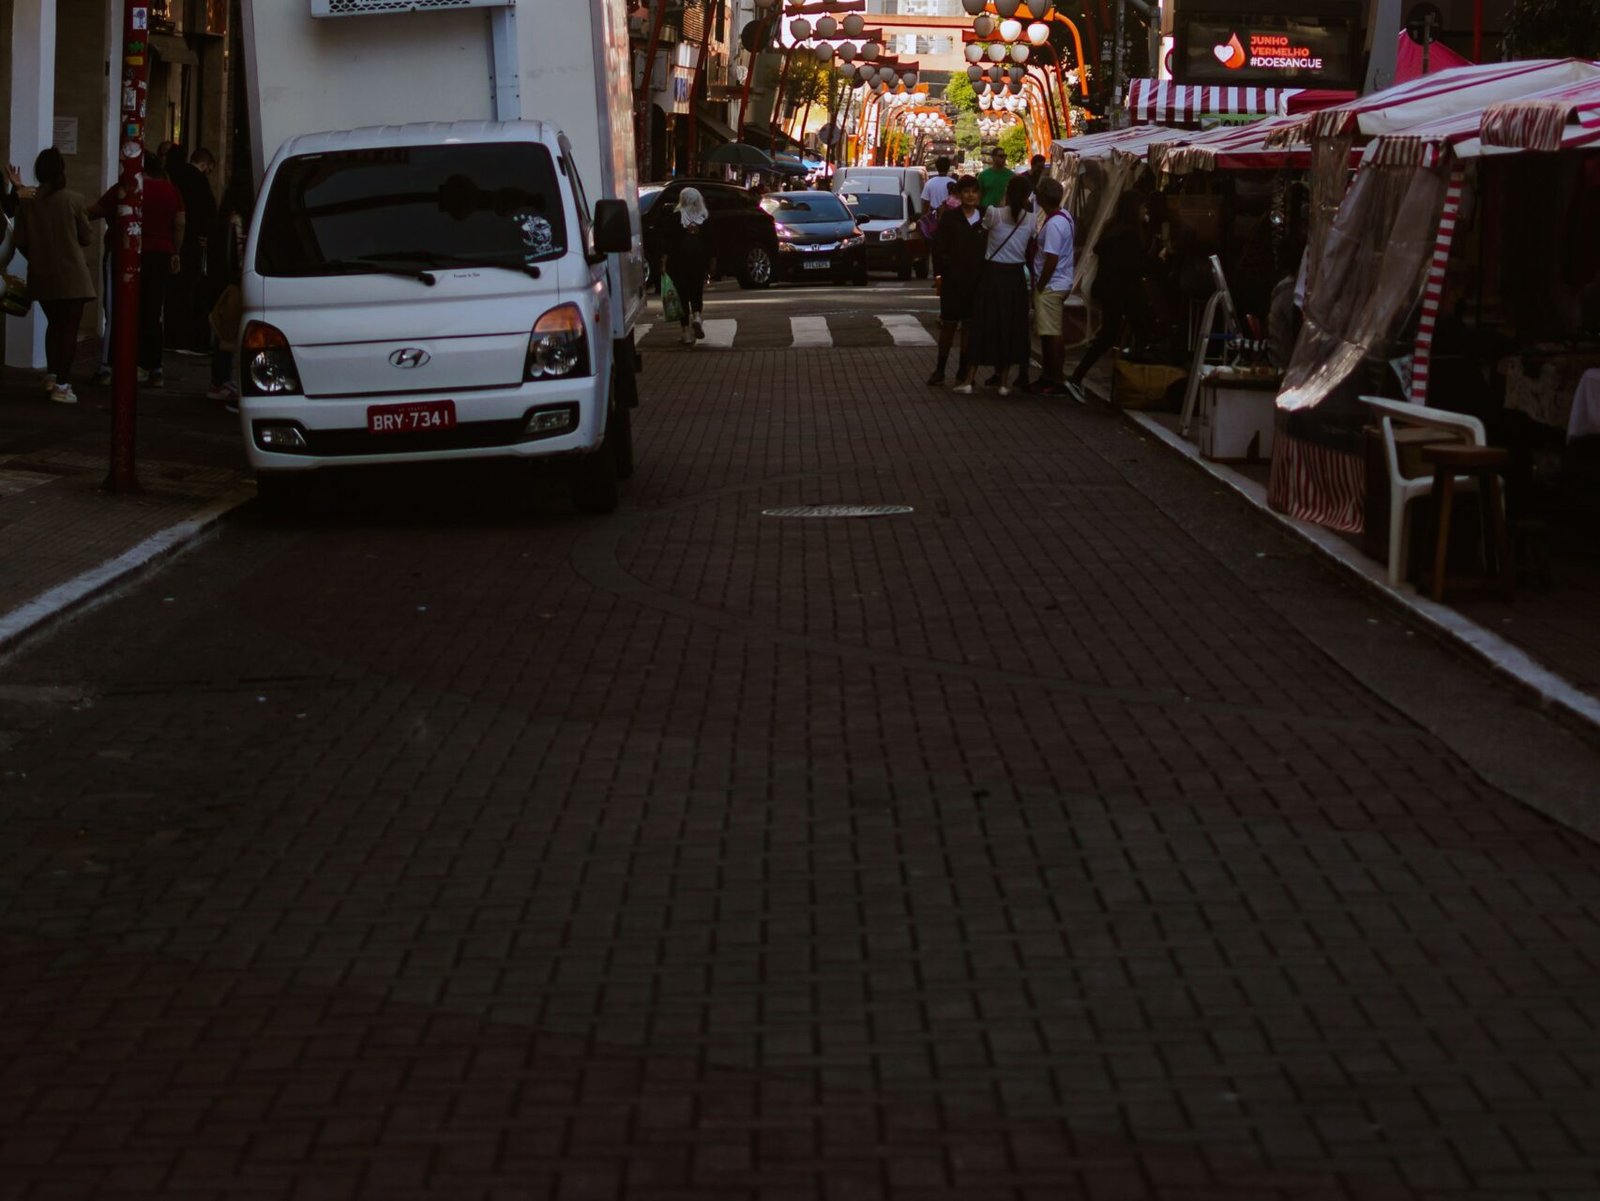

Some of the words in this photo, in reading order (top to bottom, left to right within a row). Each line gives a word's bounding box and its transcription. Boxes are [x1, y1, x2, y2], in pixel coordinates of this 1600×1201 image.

[1250, 36, 1288, 45] JUNHO
[1250, 46, 1310, 57] VERMELHO
[1250, 56, 1322, 68] #DOESANGUE
